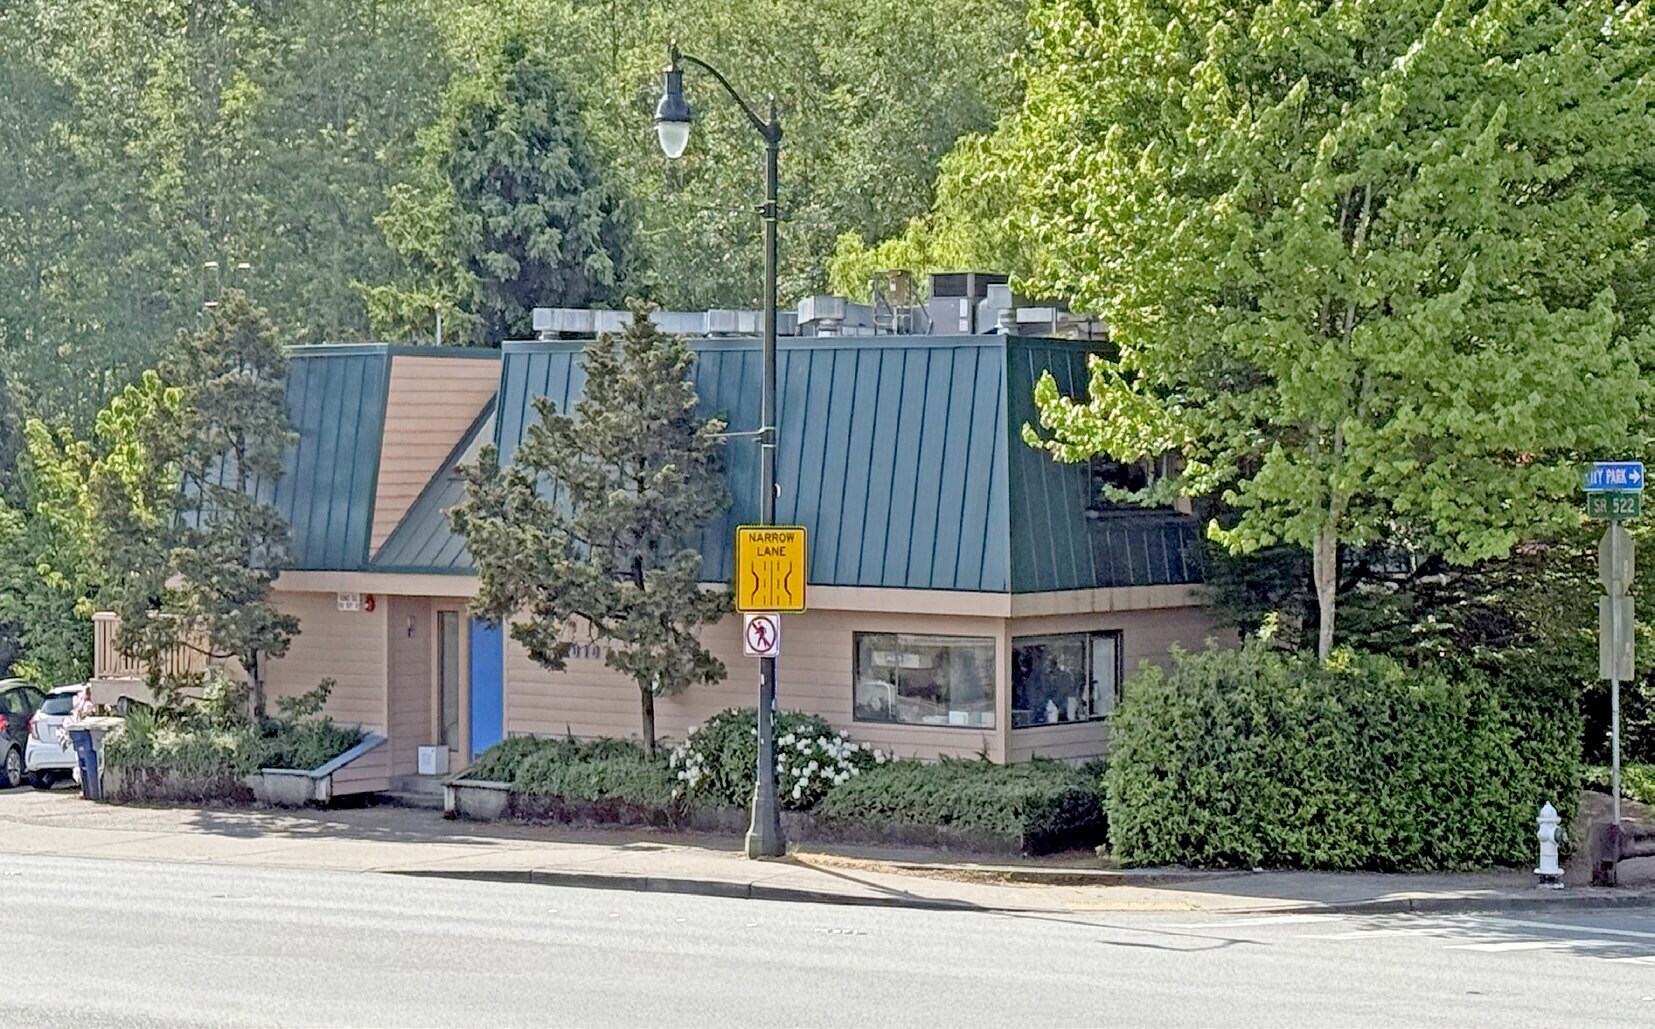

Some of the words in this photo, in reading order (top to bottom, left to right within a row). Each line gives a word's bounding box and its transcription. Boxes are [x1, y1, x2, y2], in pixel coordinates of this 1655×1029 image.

[1585, 469, 1603, 484] ITY
[1606, 469, 1627, 484] PARK
[1593, 498, 1607, 513] SR
[1613, 498, 1634, 513] 522
[749, 532, 795, 543] NARROW
[757, 546, 786, 557] LANE
